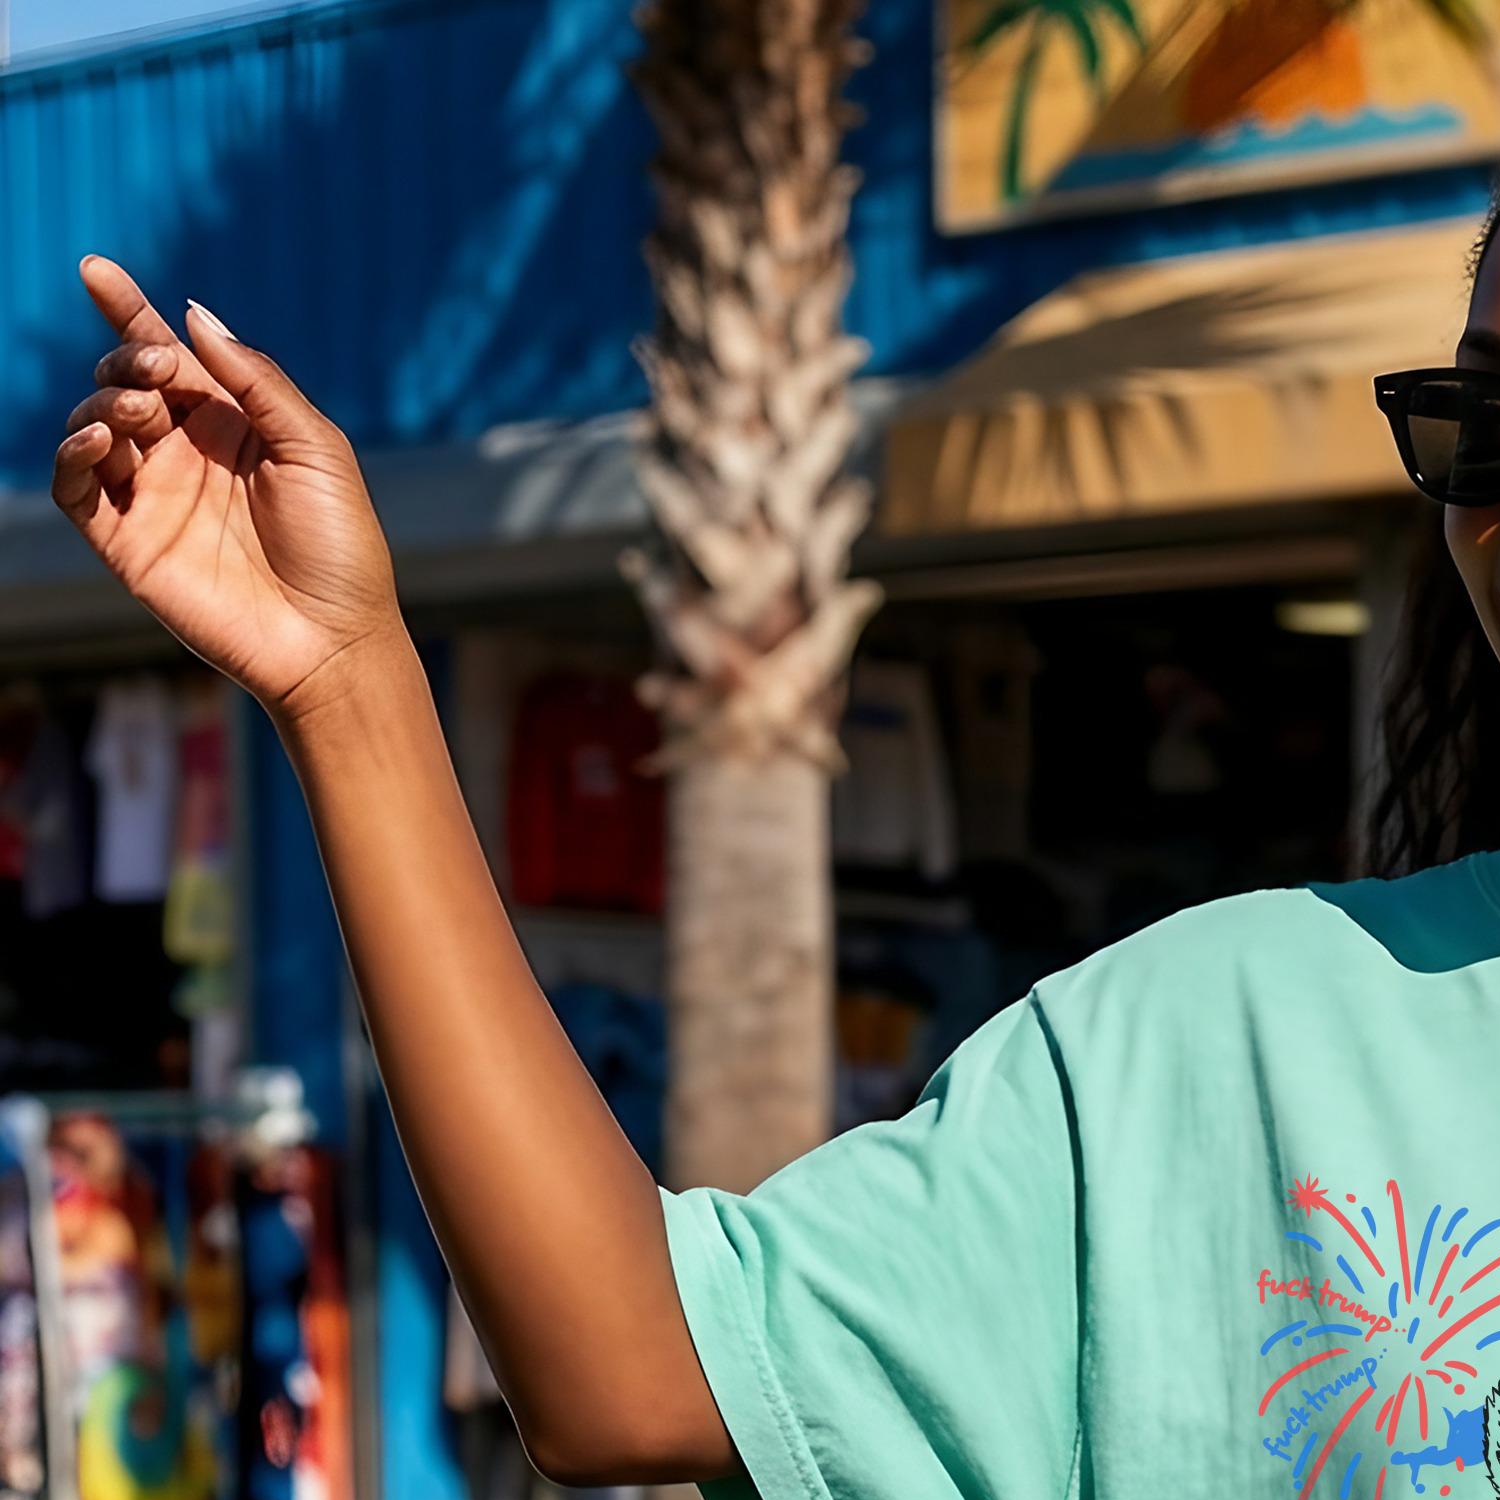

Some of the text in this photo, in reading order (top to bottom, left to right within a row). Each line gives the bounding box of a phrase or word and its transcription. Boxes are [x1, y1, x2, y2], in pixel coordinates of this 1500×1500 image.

[1257, 1269, 1391, 1342] fuck trump
[1263, 1357, 1378, 1462] fuck trump
